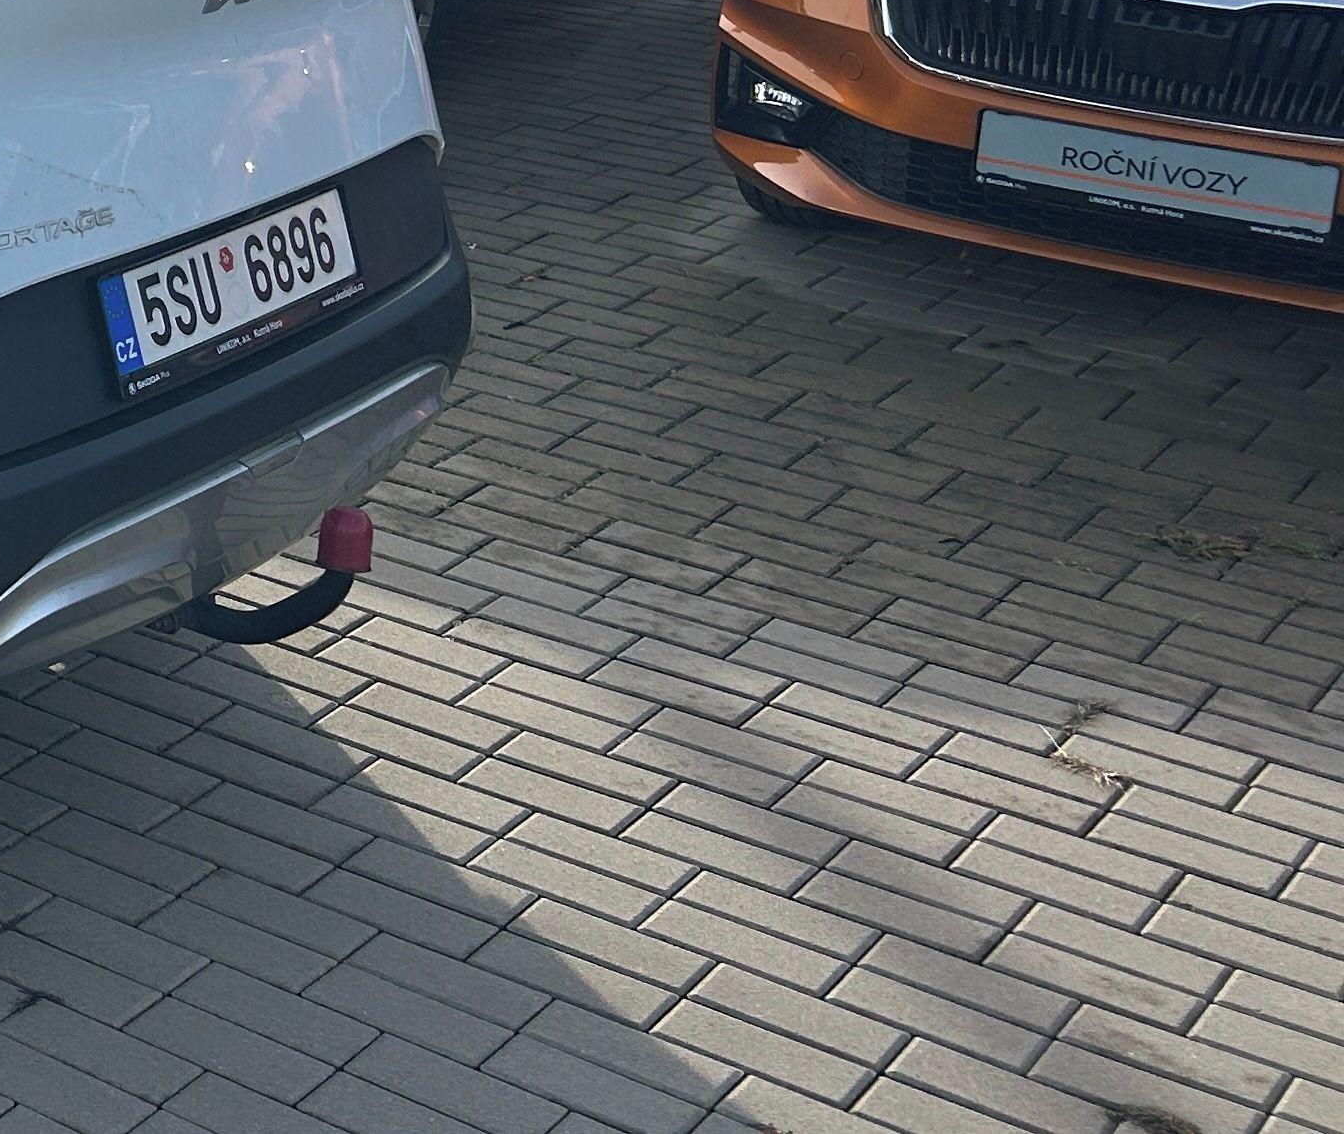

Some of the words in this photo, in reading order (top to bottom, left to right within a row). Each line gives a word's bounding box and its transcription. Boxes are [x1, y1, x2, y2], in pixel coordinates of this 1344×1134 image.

[1061, 144, 1159, 184] ROČNÍ
[1162, 162, 1249, 196] VOZY
[136, 252, 222, 347] 5SU
[243, 207, 337, 303] 6896
[115, 337, 138, 363] CZ
